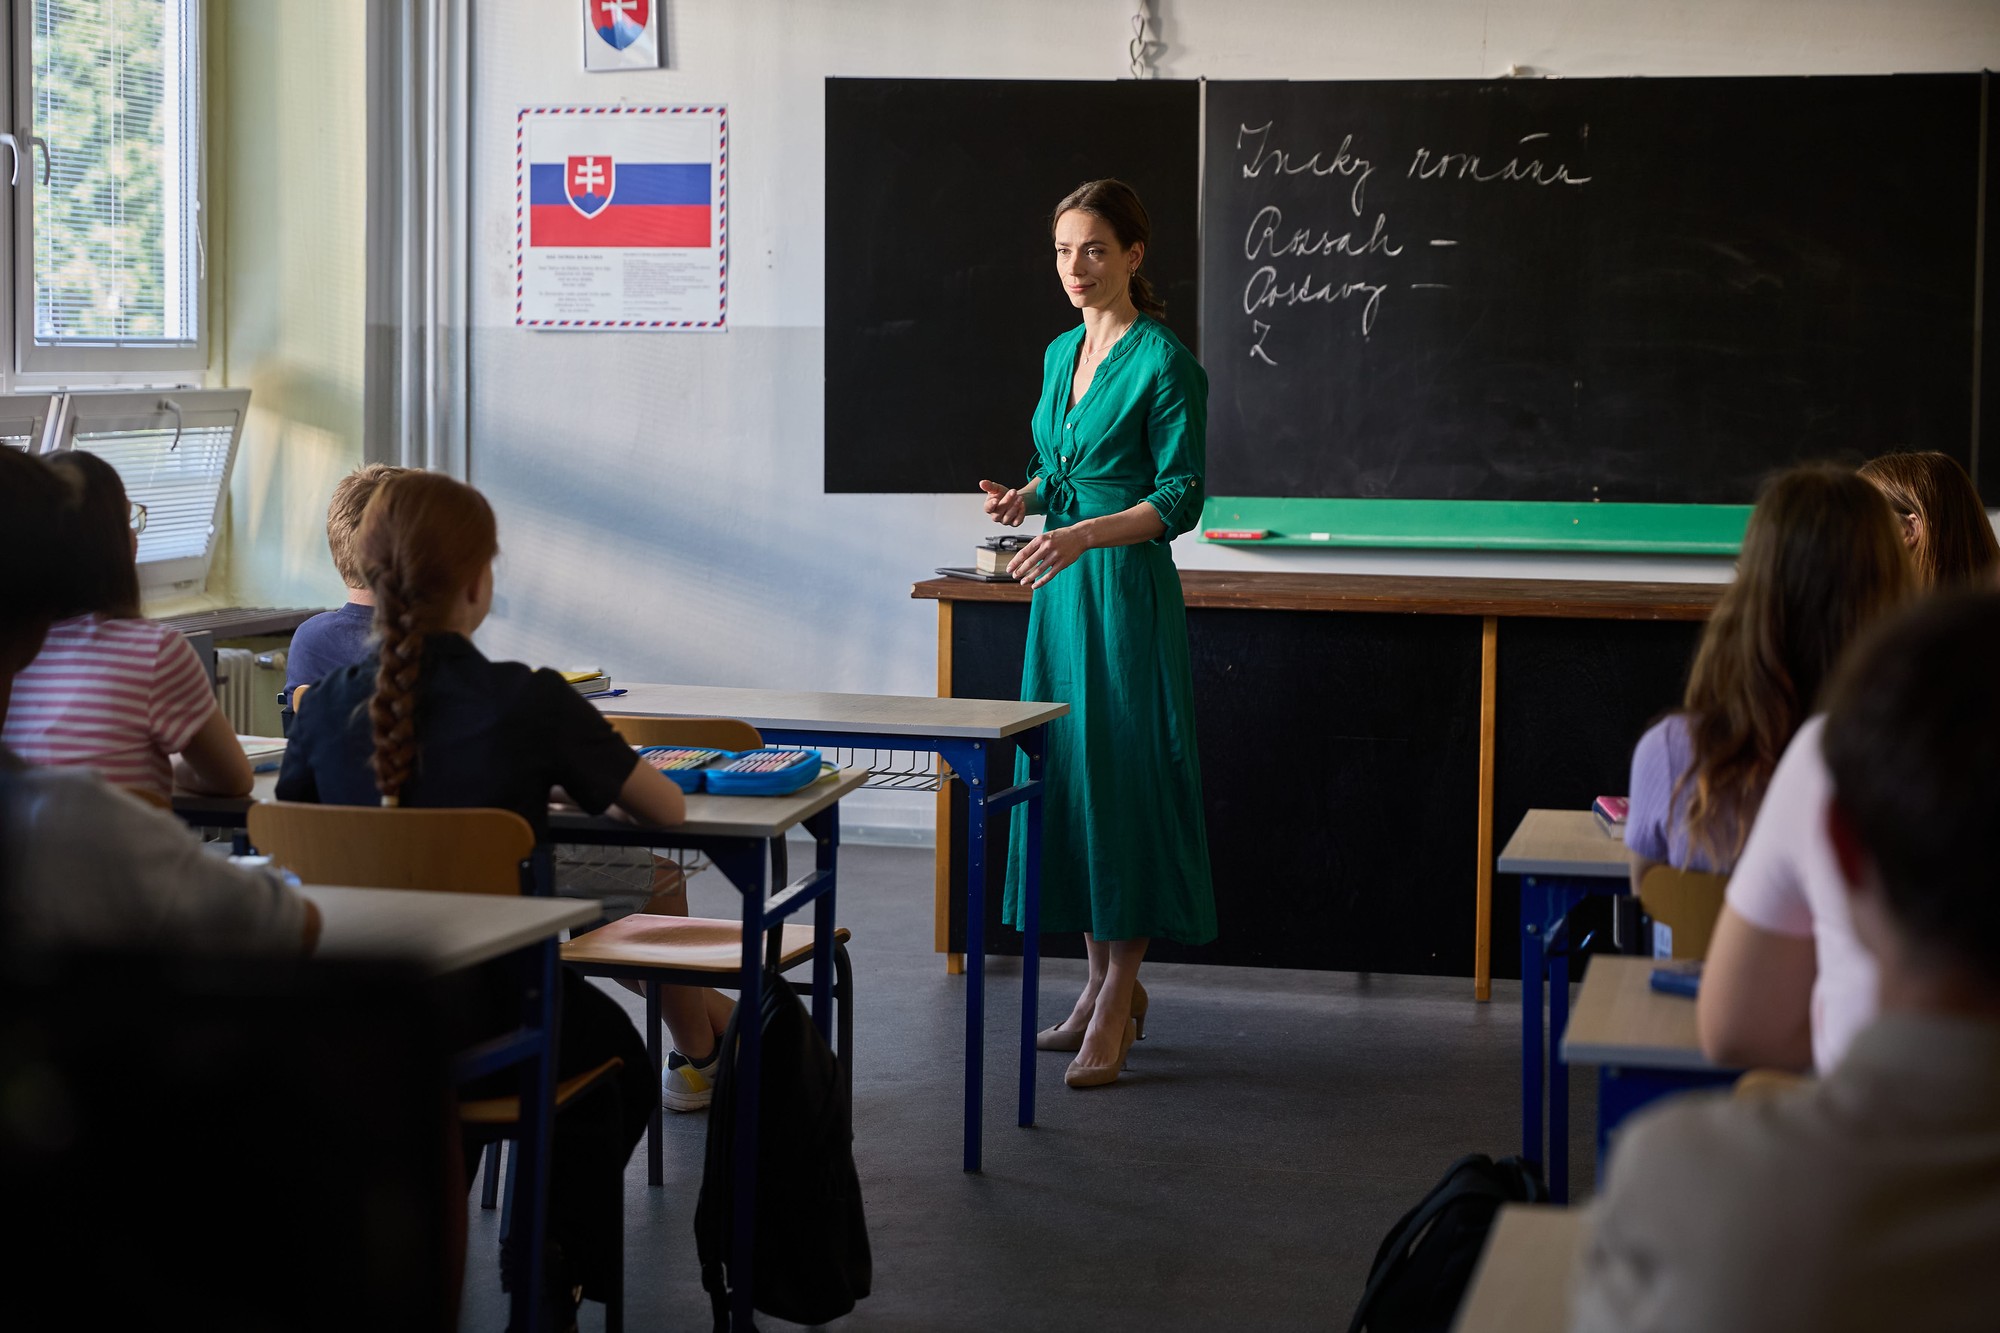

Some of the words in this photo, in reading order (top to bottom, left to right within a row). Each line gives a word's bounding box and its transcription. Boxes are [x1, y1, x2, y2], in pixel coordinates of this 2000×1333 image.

[1236, 120, 1376, 217] Znaky
[1406, 132, 1593, 186] románu
[1244, 205, 1404, 261] Rozsah
[1242, 265, 1388, 336] Postavy
